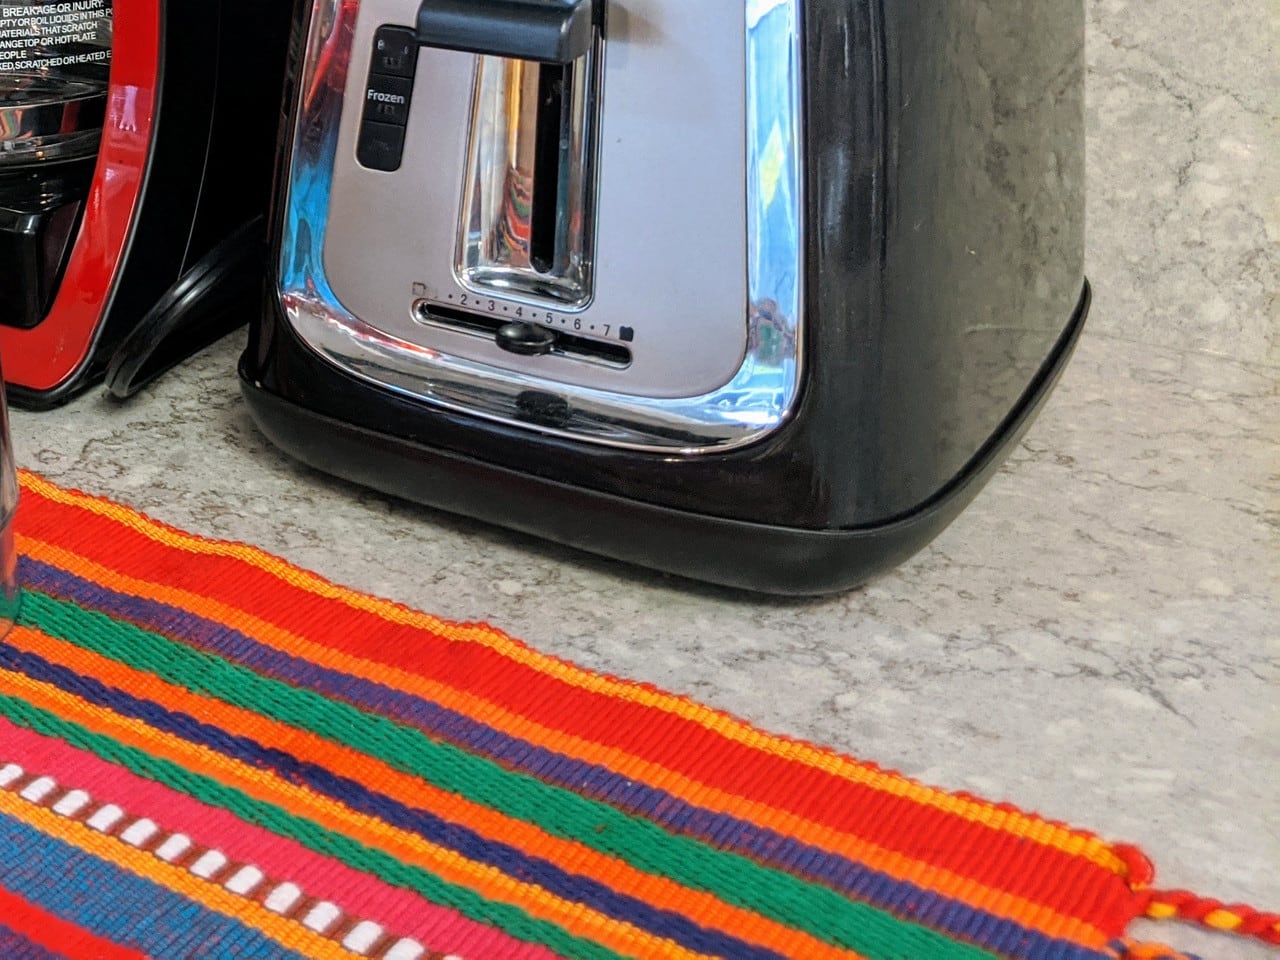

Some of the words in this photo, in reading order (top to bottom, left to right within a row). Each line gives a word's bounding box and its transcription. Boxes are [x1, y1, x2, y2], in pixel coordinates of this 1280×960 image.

[2, 4, 56, 18] BREAKAGE
[57, 3, 71, 13] OR
[17, 17, 30, 27] OR
[30, 16, 49, 25] BOIL
[49, 13, 79, 24] LIQUIDS
[80, 11, 88, 20] IN
[88, 9, 104, 19] THIS
[41, 25, 61, 35] THAT
[61, 21, 98, 33] SCRATCH
[40, 37, 54, 46] OR
[54, 34, 72, 44] HOT
[72, 31, 97, 42] PLATE
[63, 56, 75, 65] OR
[75, 51, 106, 64] HEATED
[367, 89, 405, 104] Frozen
[460, 294, 467, 306] 2
[488, 300, 495, 311] 3
[515, 306, 522, 317] 4
[545, 312, 553, 324] 5
[574, 318, 581, 330] 6
[603, 324, 610, 336] 7
